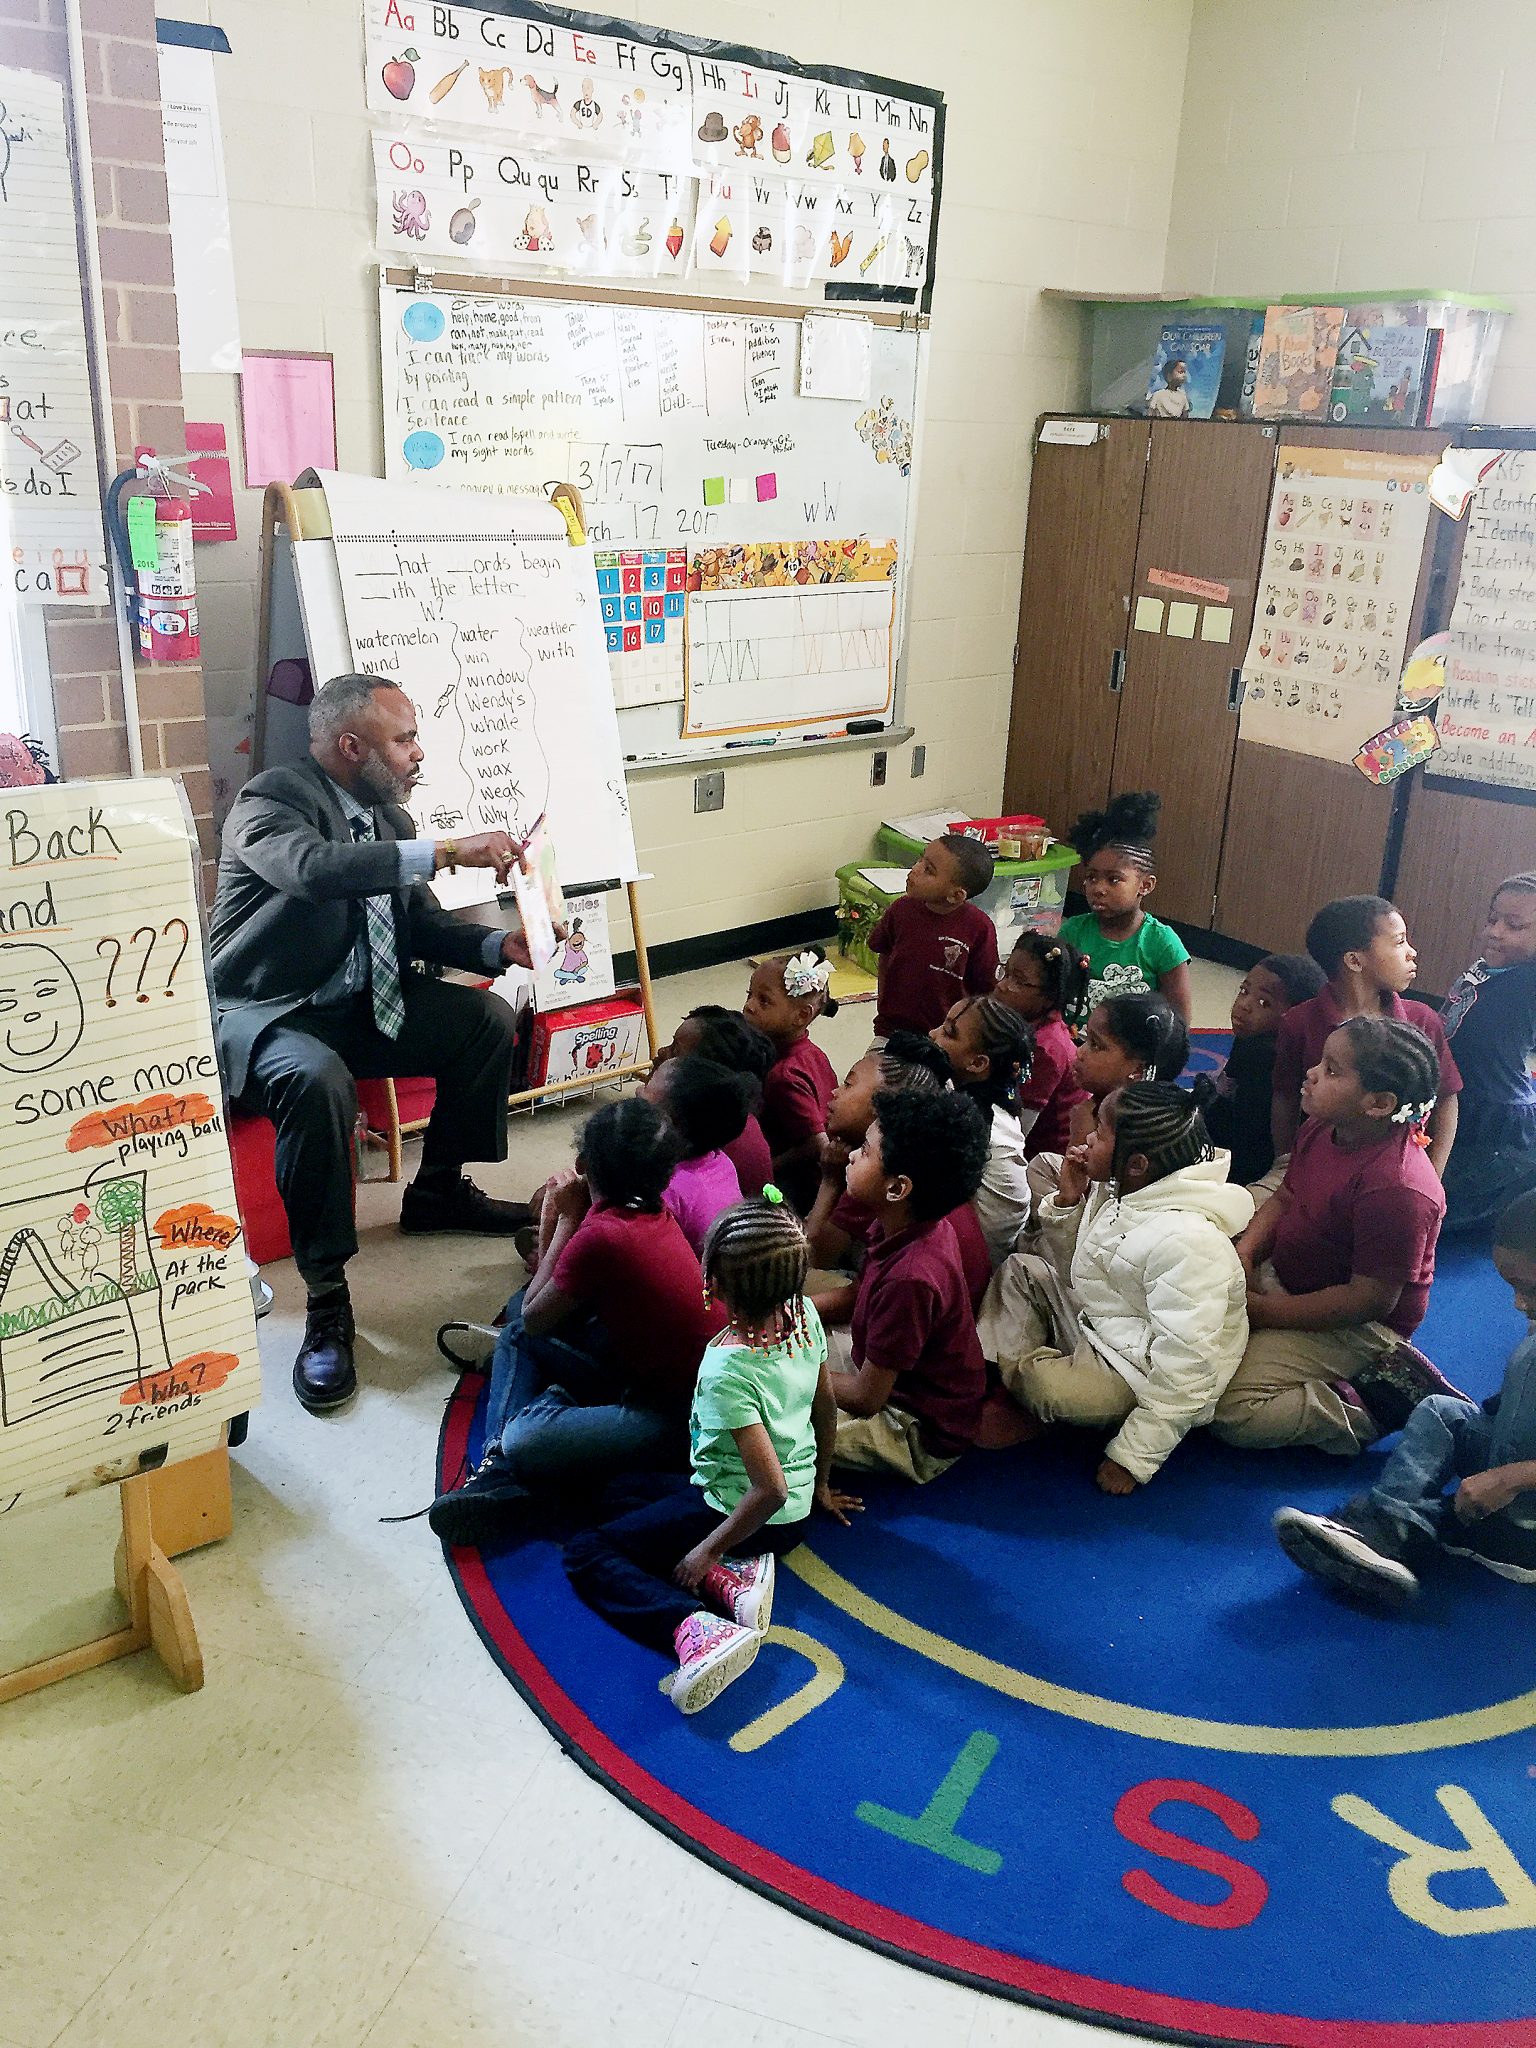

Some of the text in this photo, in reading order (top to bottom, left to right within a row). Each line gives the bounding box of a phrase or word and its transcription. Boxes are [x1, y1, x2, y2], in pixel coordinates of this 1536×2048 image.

[385, 0, 415, 31] Aa
[433, 7, 460, 39] Bb
[480, 17, 506, 49] Cc
[526, 24, 554, 57] Dd
[572, 33, 596, 65] Ee
[617, 42, 637, 71] Ff
[650, 51, 683, 91] Gg
[701, 61, 726, 91] Hh
[775, 80, 788, 118] Jj
[815, 87, 830, 116] Kk
[875, 98, 901, 127] Mm
[908, 106, 928, 133] Nn
[389, 142, 425, 173] Oo
[449, 149, 474, 193] Pp
[577, 165, 599, 193] Rr
[907, 198, 922, 223] Zz
[406, 350, 420, 366] I
[424, 351, 454, 365] can
[496, 351, 512, 364] my
[516, 350, 550, 362] words
[1282, 352, 1312, 371] Books
[404, 368, 419, 391] by
[421, 399, 448, 411] can
[453, 390, 479, 408] read
[485, 395, 493, 405] a
[502, 389, 535, 410] simple
[448, 432, 482, 445] I can
[451, 445, 534, 463] my sight words
[587, 521, 612, 541] rch
[1275, 540, 1287, 555] Gg
[136, 559, 156, 568] 2015
[521, 551, 561, 578] begin
[430, 575, 520, 597] the letter
[605, 572, 681, 589] 1 2 3 4
[605, 598, 679, 617] 8 9 10 11
[1305, 590, 1319, 602] Oo
[1326, 593, 1337, 607] Pp
[355, 627, 439, 651] watermelon
[460, 623, 499, 642] water
[526, 621, 577, 638] weather
[627, 624, 661, 646] 16 17
[361, 650, 400, 674] wind
[464, 650, 490, 664] win
[537, 641, 575, 662] with
[1378, 650, 1390, 662] Zz
[467, 670, 525, 688] window
[465, 689, 526, 713] Wendy's
[470, 715, 519, 733] whale
[1441, 713, 1490, 740] Become
[1499, 730, 1516, 746] an
[471, 738, 510, 757] work
[1437, 745, 1472, 766] Solve
[477, 762, 513, 779] wax
[5, 806, 122, 866] Back
[567, 898, 600, 914] Rules
[574, 1026, 618, 1045] Spelling
[14, 1054, 220, 1125] some more
[102, 1099, 187, 1138] What?
[118, 1115, 223, 1167] playing ball
[165, 1253, 228, 1280] At the
[171, 1276, 226, 1310] park
[102, 1393, 202, 1436] 2 friends
[855, 1729, 1003, 1875] T
[1113, 1777, 1269, 1930] S
[1330, 1784, 1536, 1937] R
